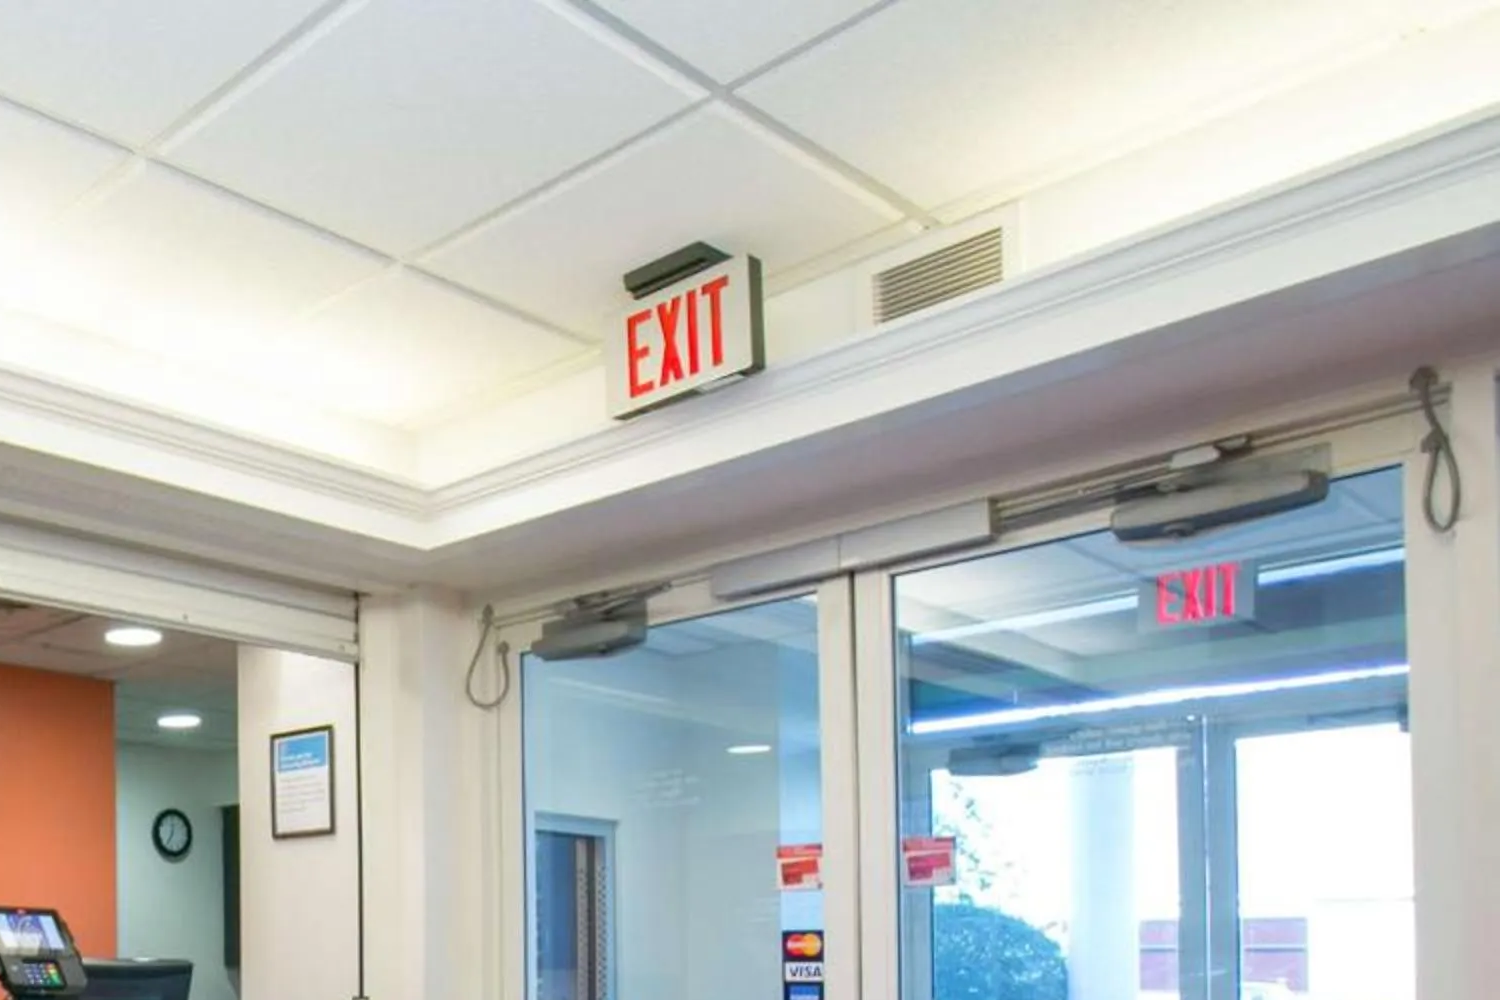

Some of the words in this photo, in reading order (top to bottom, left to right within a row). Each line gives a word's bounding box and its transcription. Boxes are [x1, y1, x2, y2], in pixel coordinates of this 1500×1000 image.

[627, 274, 729, 398] EXIT
[1156, 562, 1241, 624] EXIT
[789, 964, 822, 977] VISA
